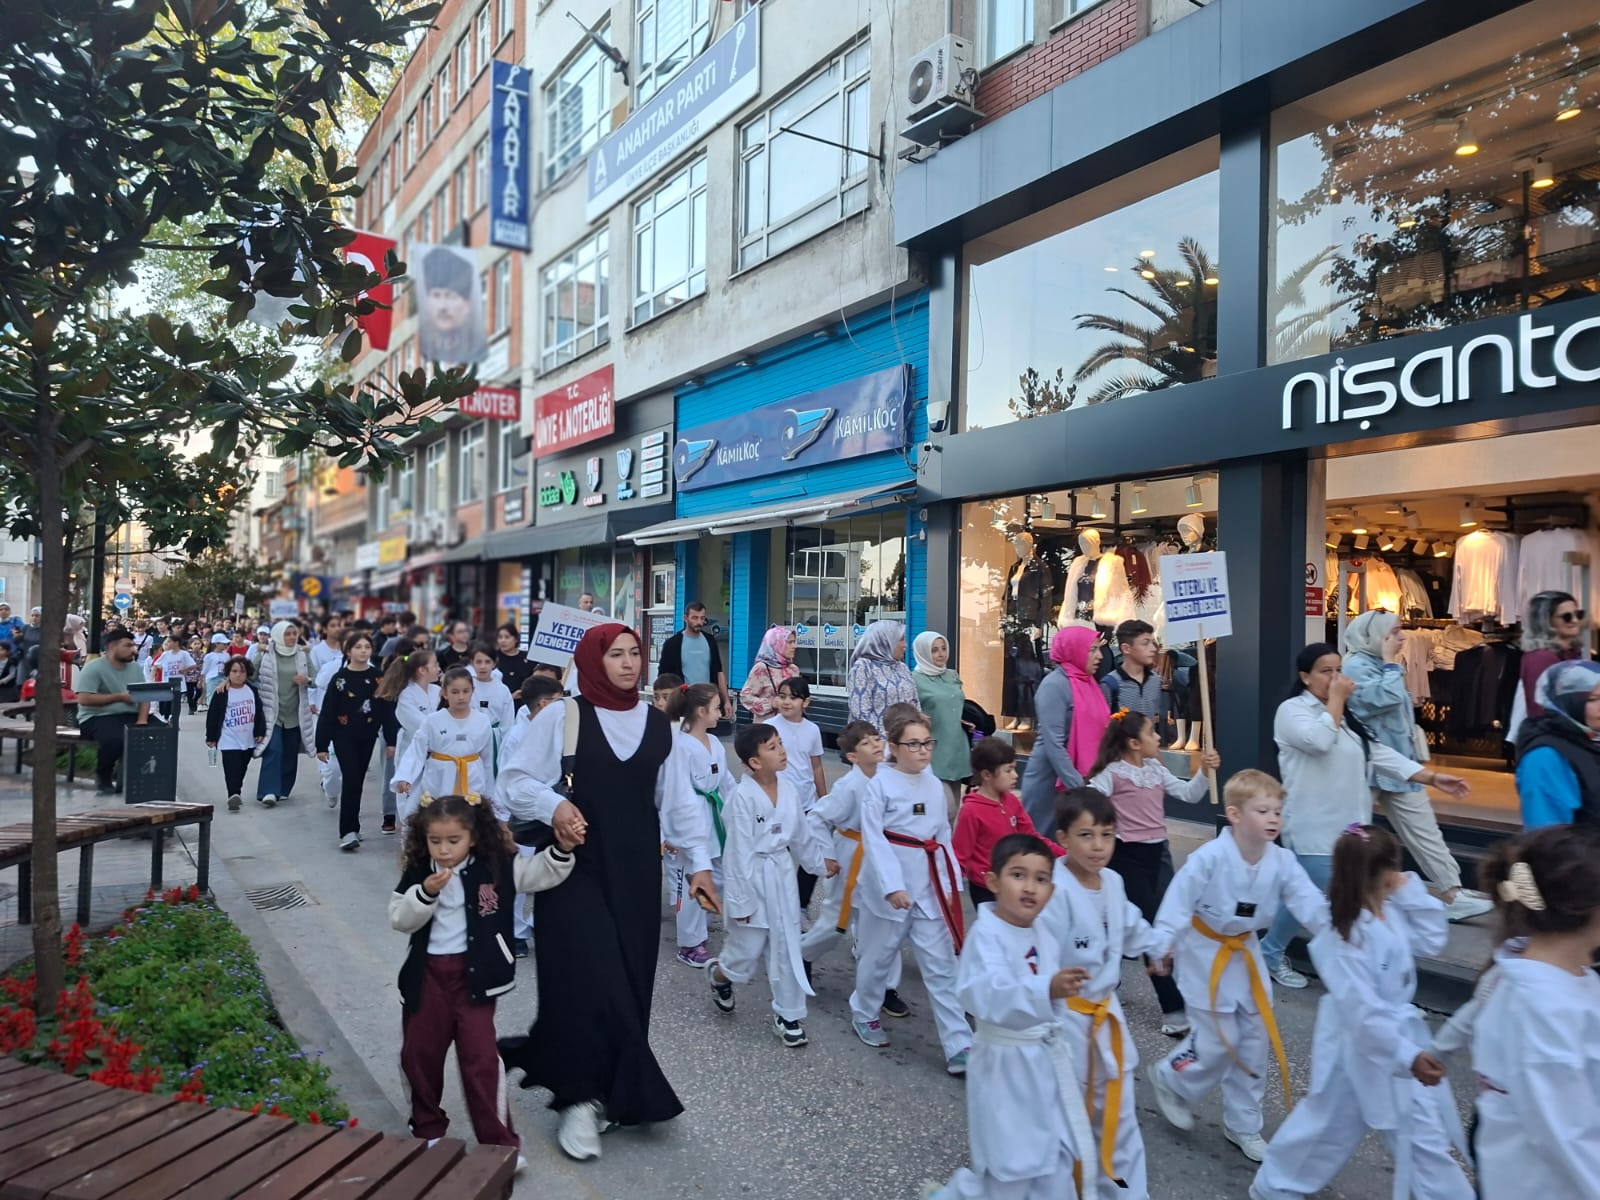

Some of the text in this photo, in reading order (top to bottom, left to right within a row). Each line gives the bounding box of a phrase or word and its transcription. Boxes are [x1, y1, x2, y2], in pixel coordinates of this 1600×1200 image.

[616, 60, 717, 167] ANAHTAR PARTİ
[503, 91, 521, 218] ANAHTAR
[463, 391, 516, 417] 1.NOTER
[552, 621, 585, 640] YETER
